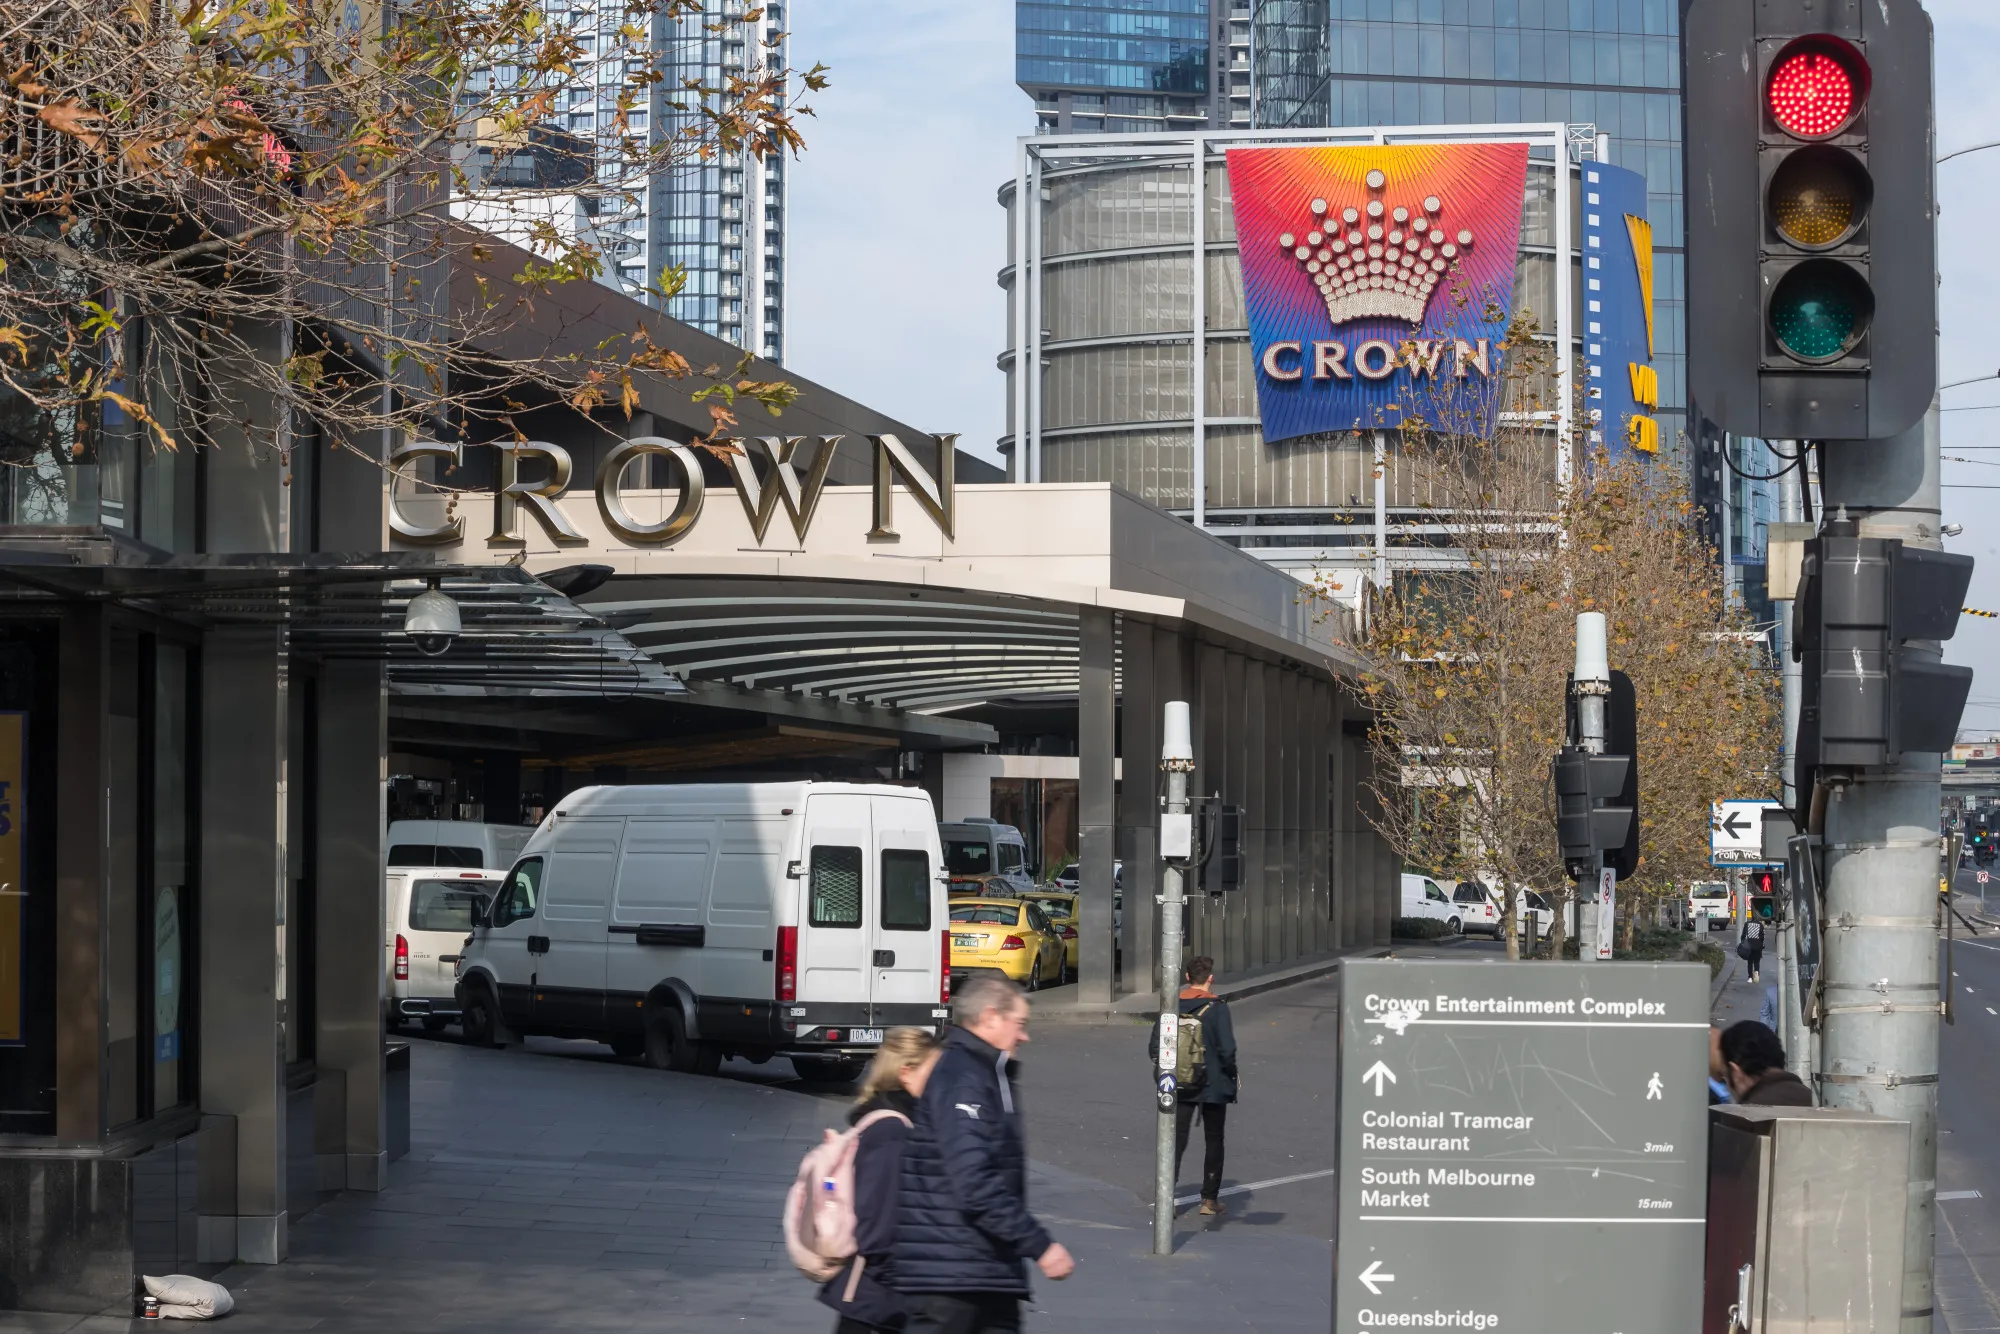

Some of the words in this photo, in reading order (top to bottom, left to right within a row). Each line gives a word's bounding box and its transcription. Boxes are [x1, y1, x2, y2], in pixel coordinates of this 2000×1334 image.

[1262, 337, 1490, 382] CROWN
[389, 431, 961, 547] CROWN
[1364, 993, 1429, 1012] Crown
[1435, 994, 1576, 1015] Entertainment
[1580, 997, 1666, 1018] Complex
[1362, 1110, 1444, 1129] Colonial
[1449, 1111, 1534, 1130] Tramcar
[1362, 1132, 1470, 1151] Restaurant
[1643, 1142, 1674, 1153] 3min
[1361, 1167, 1421, 1185] South
[1427, 1168, 1536, 1187] Melbourne
[1361, 1189, 1430, 1208] Market
[1357, 1308, 1499, 1331] Queensbridge
